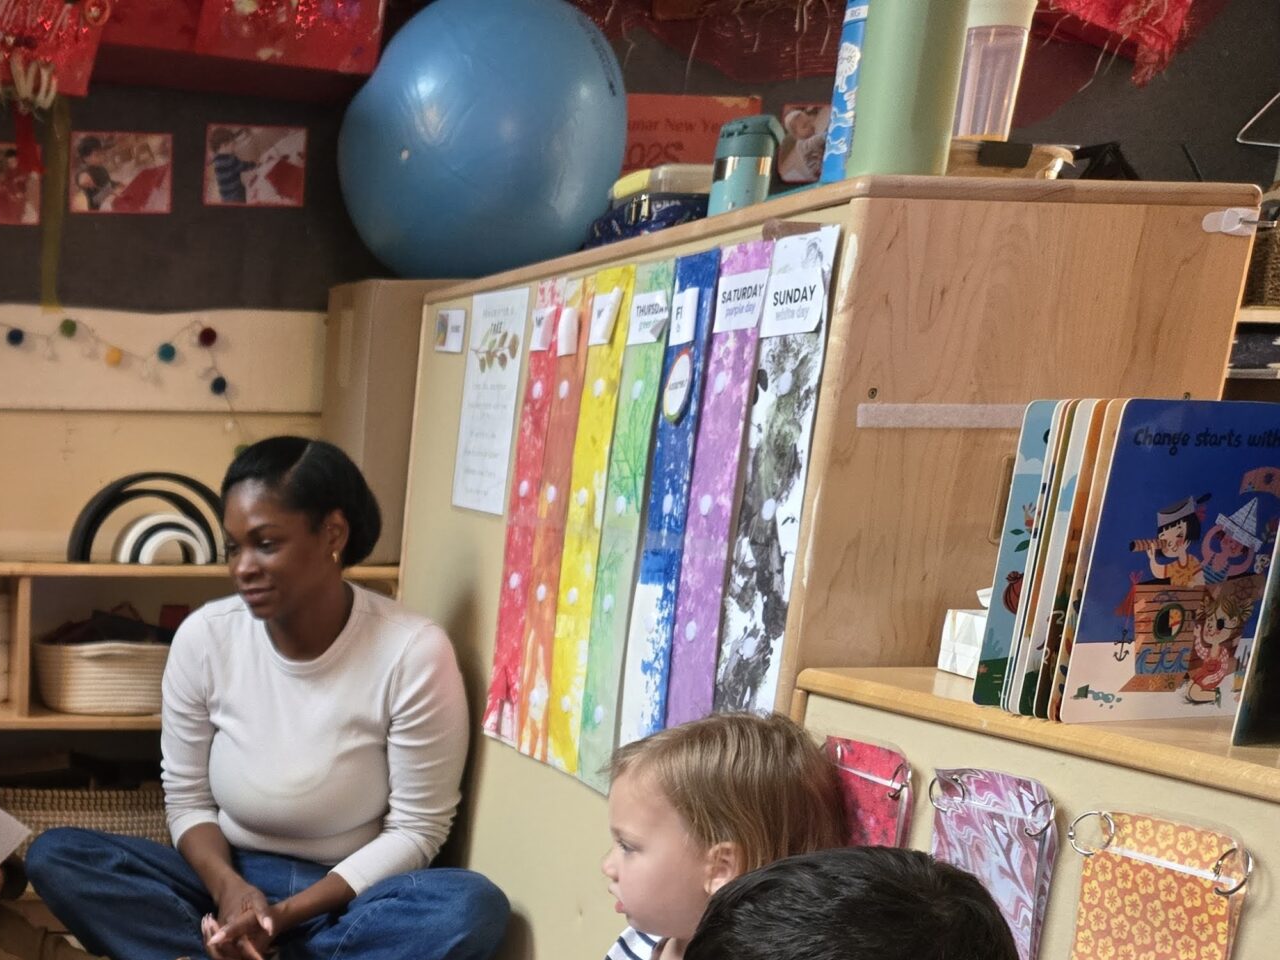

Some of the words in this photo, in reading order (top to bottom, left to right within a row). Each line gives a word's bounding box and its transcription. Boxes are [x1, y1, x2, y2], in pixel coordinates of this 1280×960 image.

[665, 118, 696, 132] New
[721, 283, 764, 304] SATURDAY
[773, 284, 817, 306] SUNDAY
[1134, 427, 1190, 456] Change
[1195, 428, 1242, 448] starts
